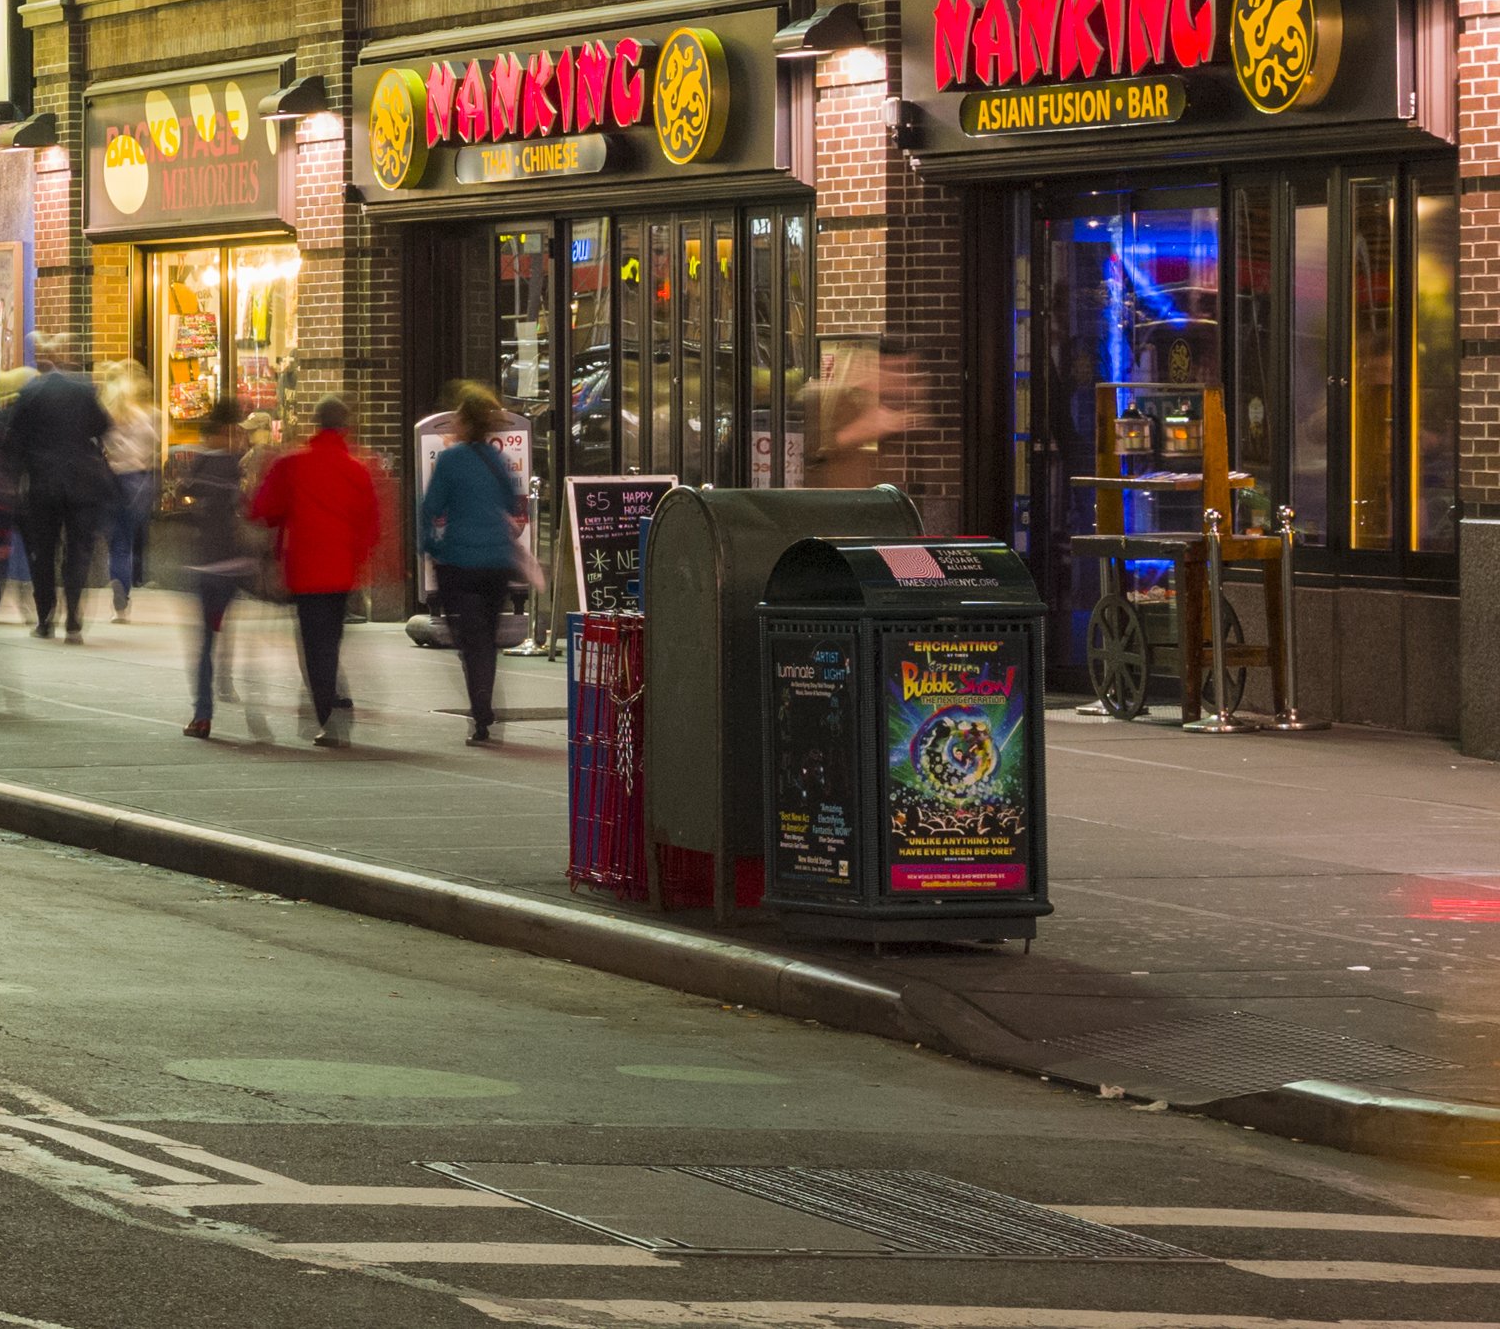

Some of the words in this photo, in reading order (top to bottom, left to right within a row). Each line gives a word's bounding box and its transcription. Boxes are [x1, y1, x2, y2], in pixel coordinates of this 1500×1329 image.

[425, 36, 646, 147] NANKING
[977, 91, 1035, 131] ASIAN
[1038, 86, 1112, 126] FUSION
[1128, 83, 1170, 120] BAR
[106, 110, 240, 168] BACKSTAGE
[481, 149, 512, 177] THAI
[521, 142, 580, 174] CHINESE
[161, 159, 260, 211] MEMORIES
[586, 492, 611, 510] $5
[622, 491, 653, 504] HAPPY
[623, 504, 651, 515] HOURS
[938, 556, 981, 564] SQUARE
[901, 660, 957, 702] Bubble
